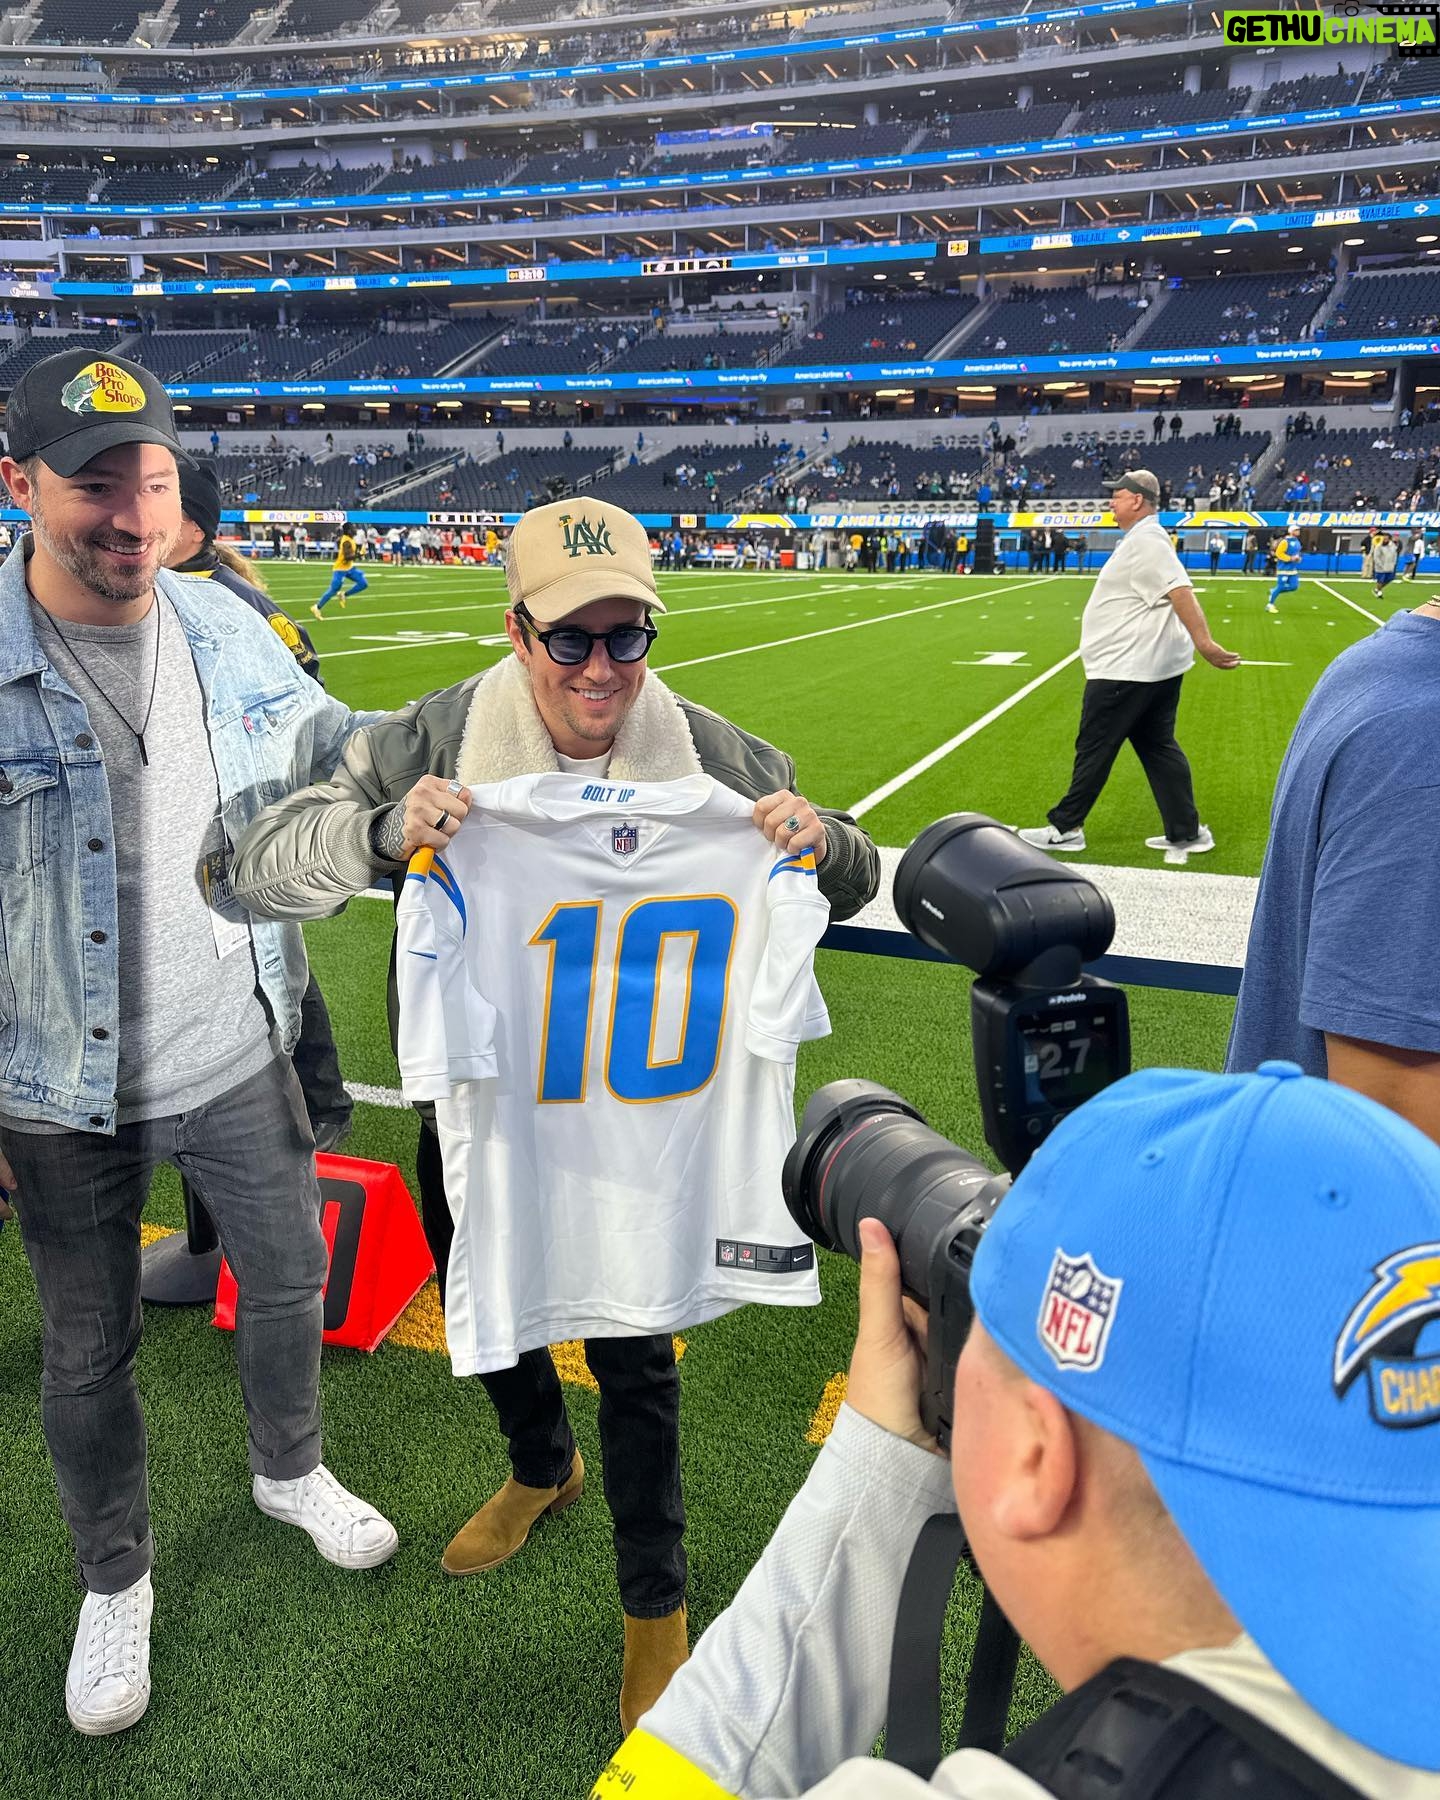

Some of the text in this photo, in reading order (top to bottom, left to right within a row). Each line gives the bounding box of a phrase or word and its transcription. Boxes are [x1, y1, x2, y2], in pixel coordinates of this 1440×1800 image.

[1360, 343, 1428, 353] American Airlines
[1151, 354, 1210, 364] American Airlines
[95, 363, 128, 381] Bass
[101, 378, 124, 391] Pro
[104, 390, 143, 407] Shops
[810, 515, 836, 527] LOS
[837, 515, 900, 527] ANGELES
[1287, 513, 1322, 526] LOS
[1323, 513, 1409, 527] ANGELES
[581, 784, 636, 803] BOLT UP
[527, 893, 740, 1105] 10
[1040, 1037, 1091, 1079] 2.7
[1045, 1295, 1092, 1354] NFL
